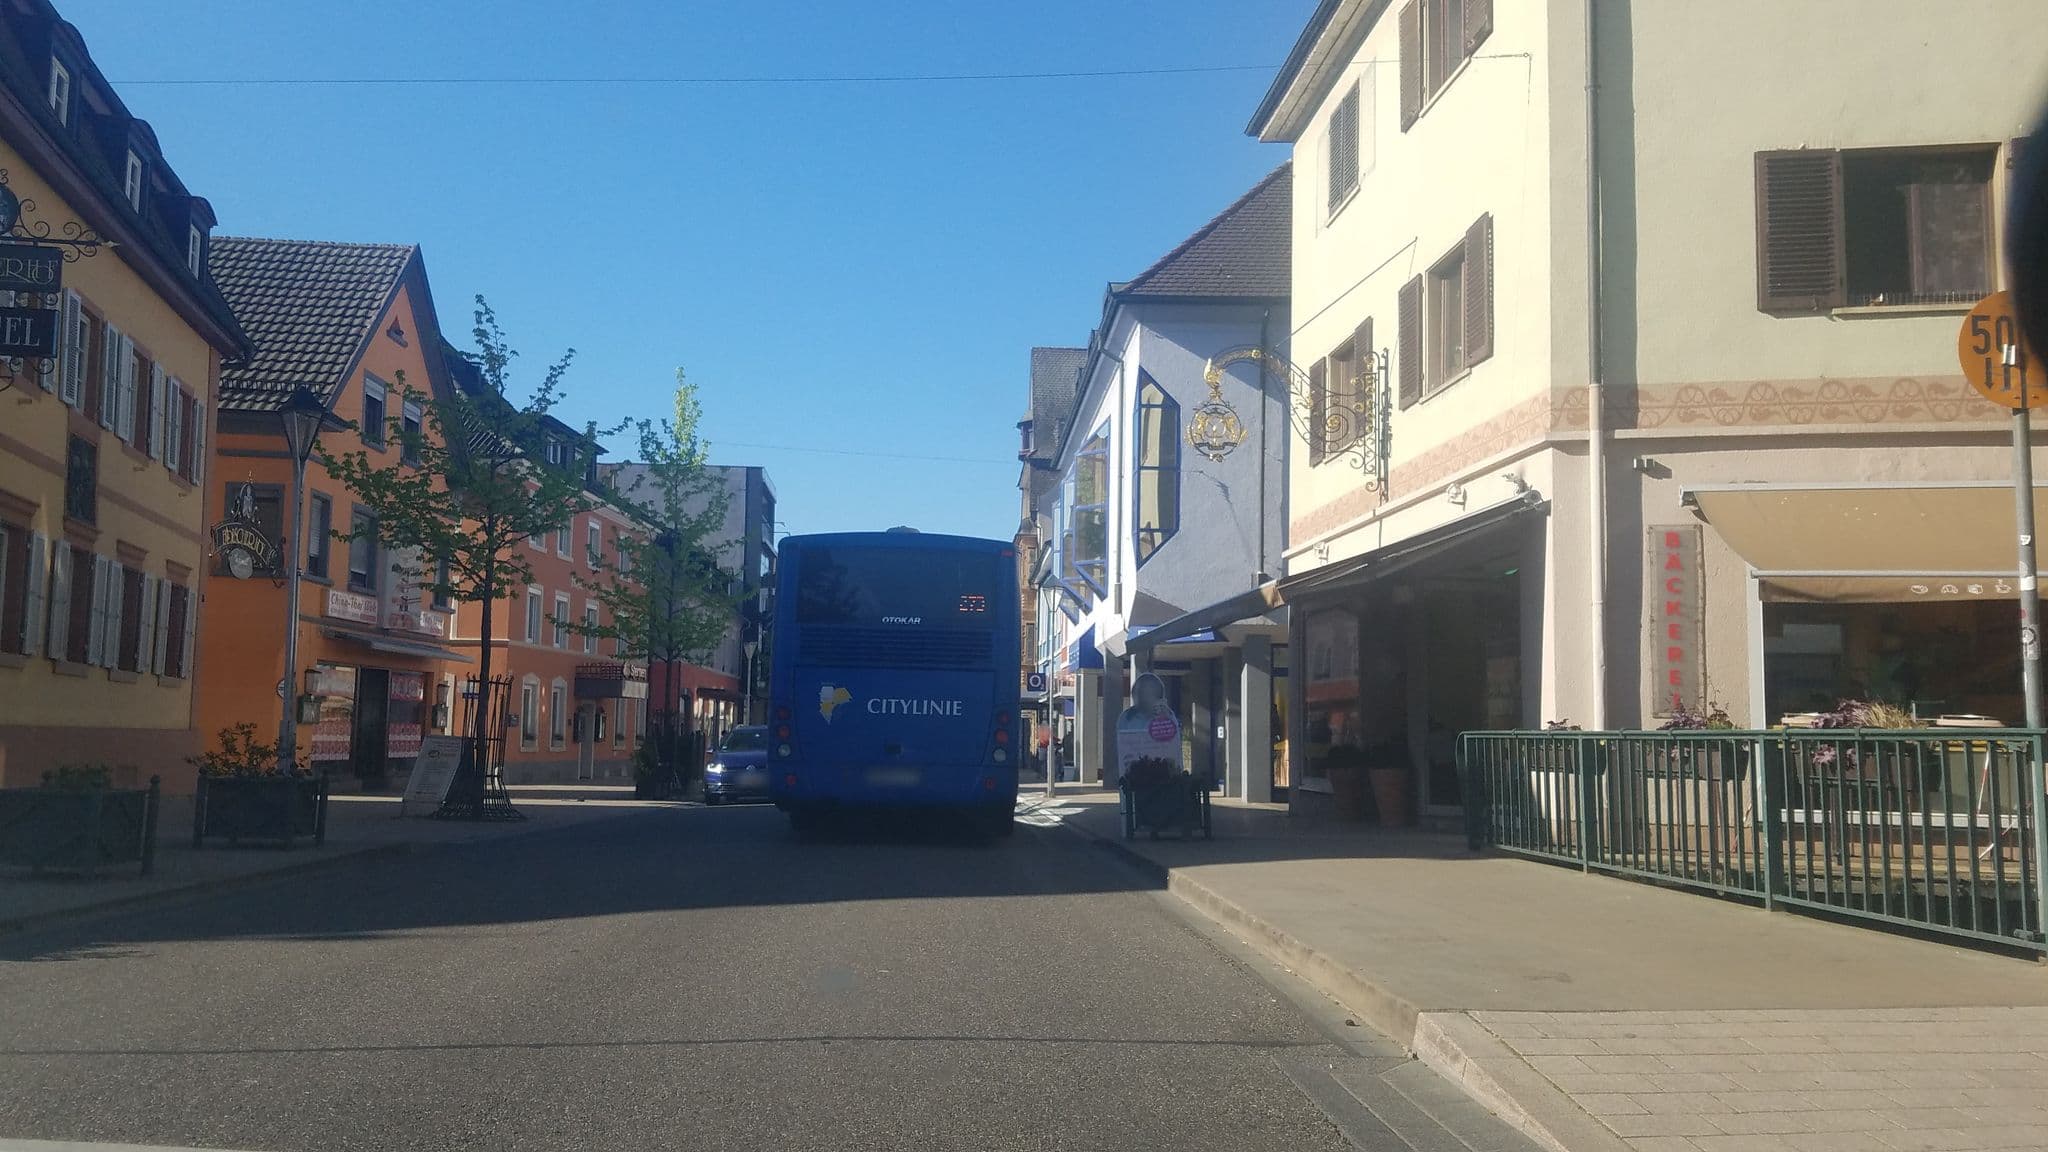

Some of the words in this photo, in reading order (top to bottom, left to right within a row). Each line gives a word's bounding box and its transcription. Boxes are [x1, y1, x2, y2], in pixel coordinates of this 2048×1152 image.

[0, 316, 40, 346] EL
[1971, 314, 2015, 355] 50
[881, 616, 921, 625] OTOKAR
[867, 698, 962, 716] CITYLINIE
